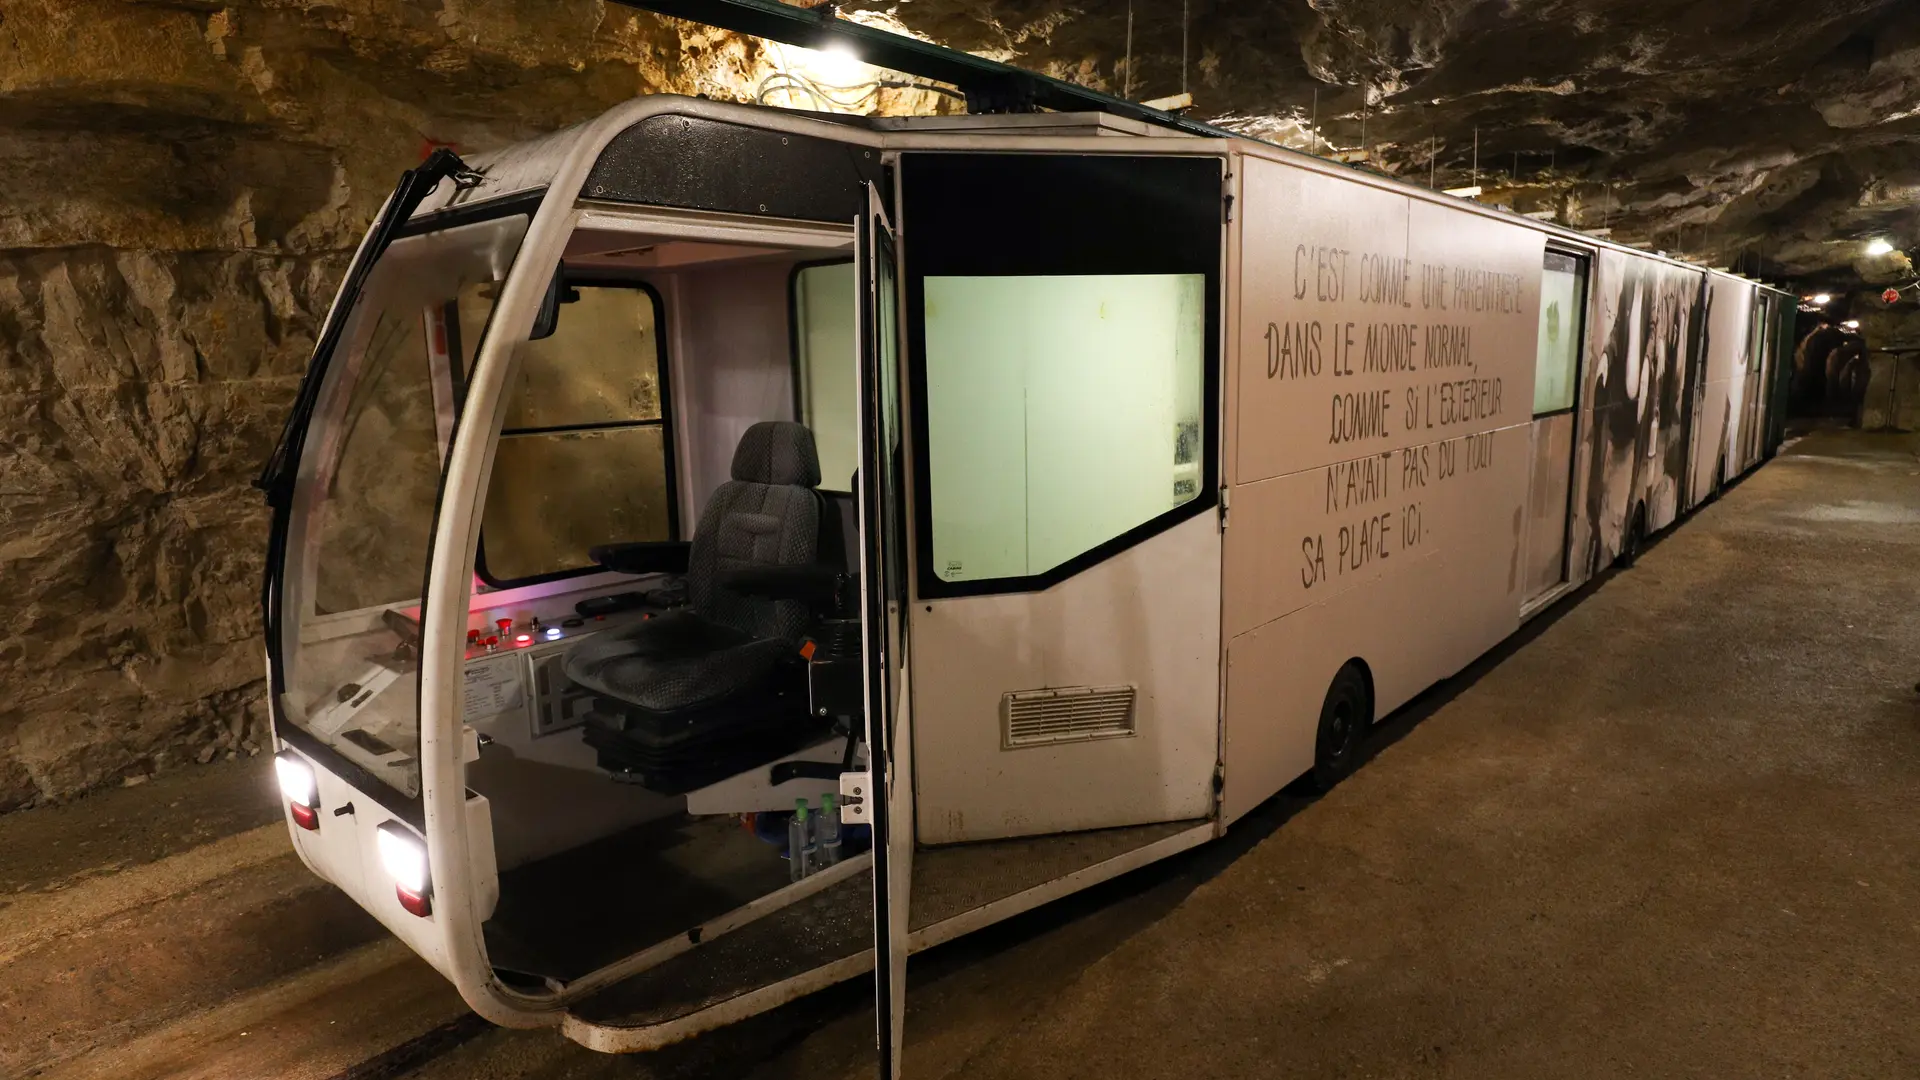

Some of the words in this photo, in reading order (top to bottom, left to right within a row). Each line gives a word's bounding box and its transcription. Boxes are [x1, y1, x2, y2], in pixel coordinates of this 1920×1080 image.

[1293, 243, 1350, 302] C'EST
[1360, 252, 1411, 308] COMME
[1422, 263, 1447, 311] UNE
[1264, 320, 1322, 380] DANS
[1334, 322, 1354, 377] LE
[1363, 323, 1417, 373] MONDE
[1424, 324, 1478, 374] NORMAL,
[1329, 390, 1391, 444] COMME
[1402, 445, 1429, 492] PAS
[1438, 440, 1456, 481] DU
[1465, 431, 1496, 473] TOUT
[1301, 534, 1327, 590] SA
[1338, 512, 1391, 576] PLACE
